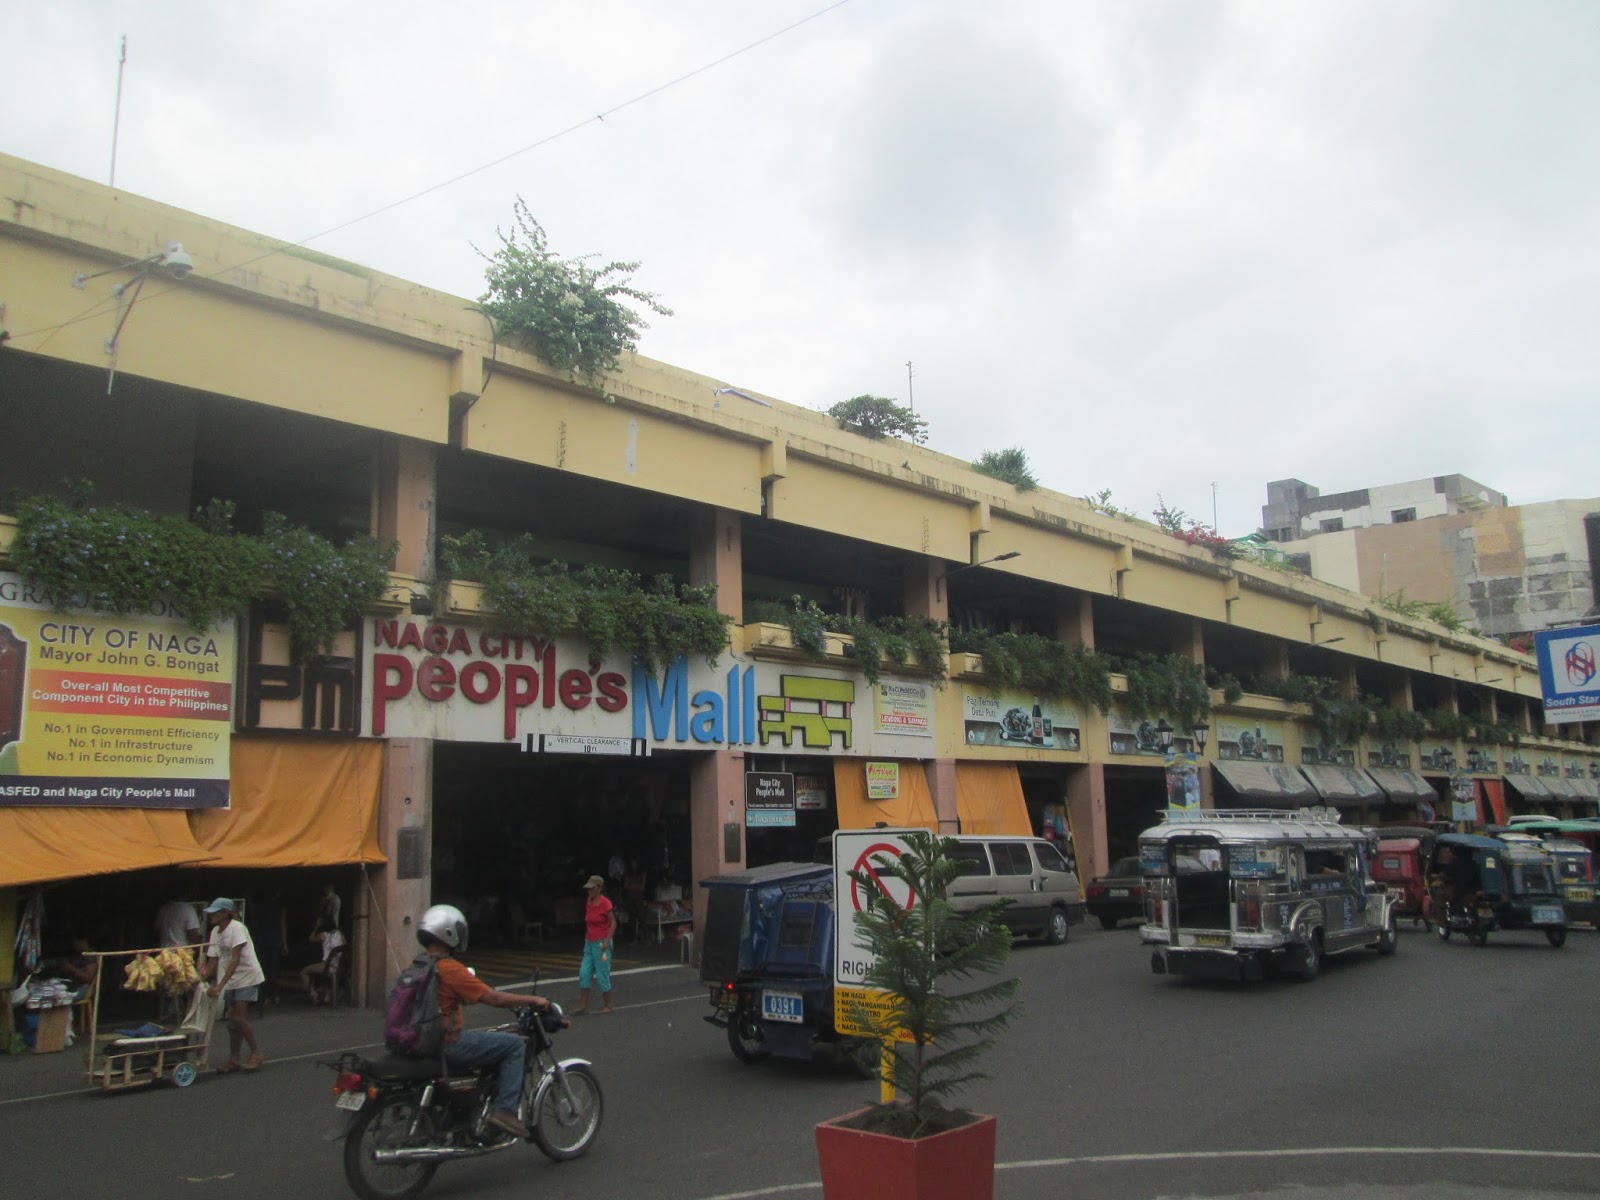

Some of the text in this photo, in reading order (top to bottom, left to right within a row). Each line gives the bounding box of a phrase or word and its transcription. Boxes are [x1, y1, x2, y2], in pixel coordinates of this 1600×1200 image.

[39, 622, 219, 657] CITY OF NAGA
[374, 618, 473, 656] NAGA
[479, 631, 549, 662] CITY
[40, 645, 219, 674] Mayor John G. Bongat
[61, 679, 210, 699] Over-all Most Competitive
[32, 690, 228, 712] Component City in the Philippines
[632, 650, 755, 745] Mall
[1546, 694, 1600, 707] South Star
[44, 723, 220, 741] No.1 in Government Efficiency
[69, 737, 193, 751] No.1 in Infrastructure
[556, 736, 620, 746] VERTICAL CLEARANCE
[584, 745, 591, 753] 10
[47, 751, 214, 766] No.1 in Economic Dynamism
[760, 779, 781, 790] Naga City
[43, 786, 65, 797] and
[69, 787, 97, 800] Naga
[101, 787, 123, 800] City
[126, 787, 172, 798] People's
[174, 788, 195, 798] Mall
[756, 788, 785, 797] People's Mall
[842, 960, 875, 975] RIGH
[770, 997, 795, 1015] 0391
